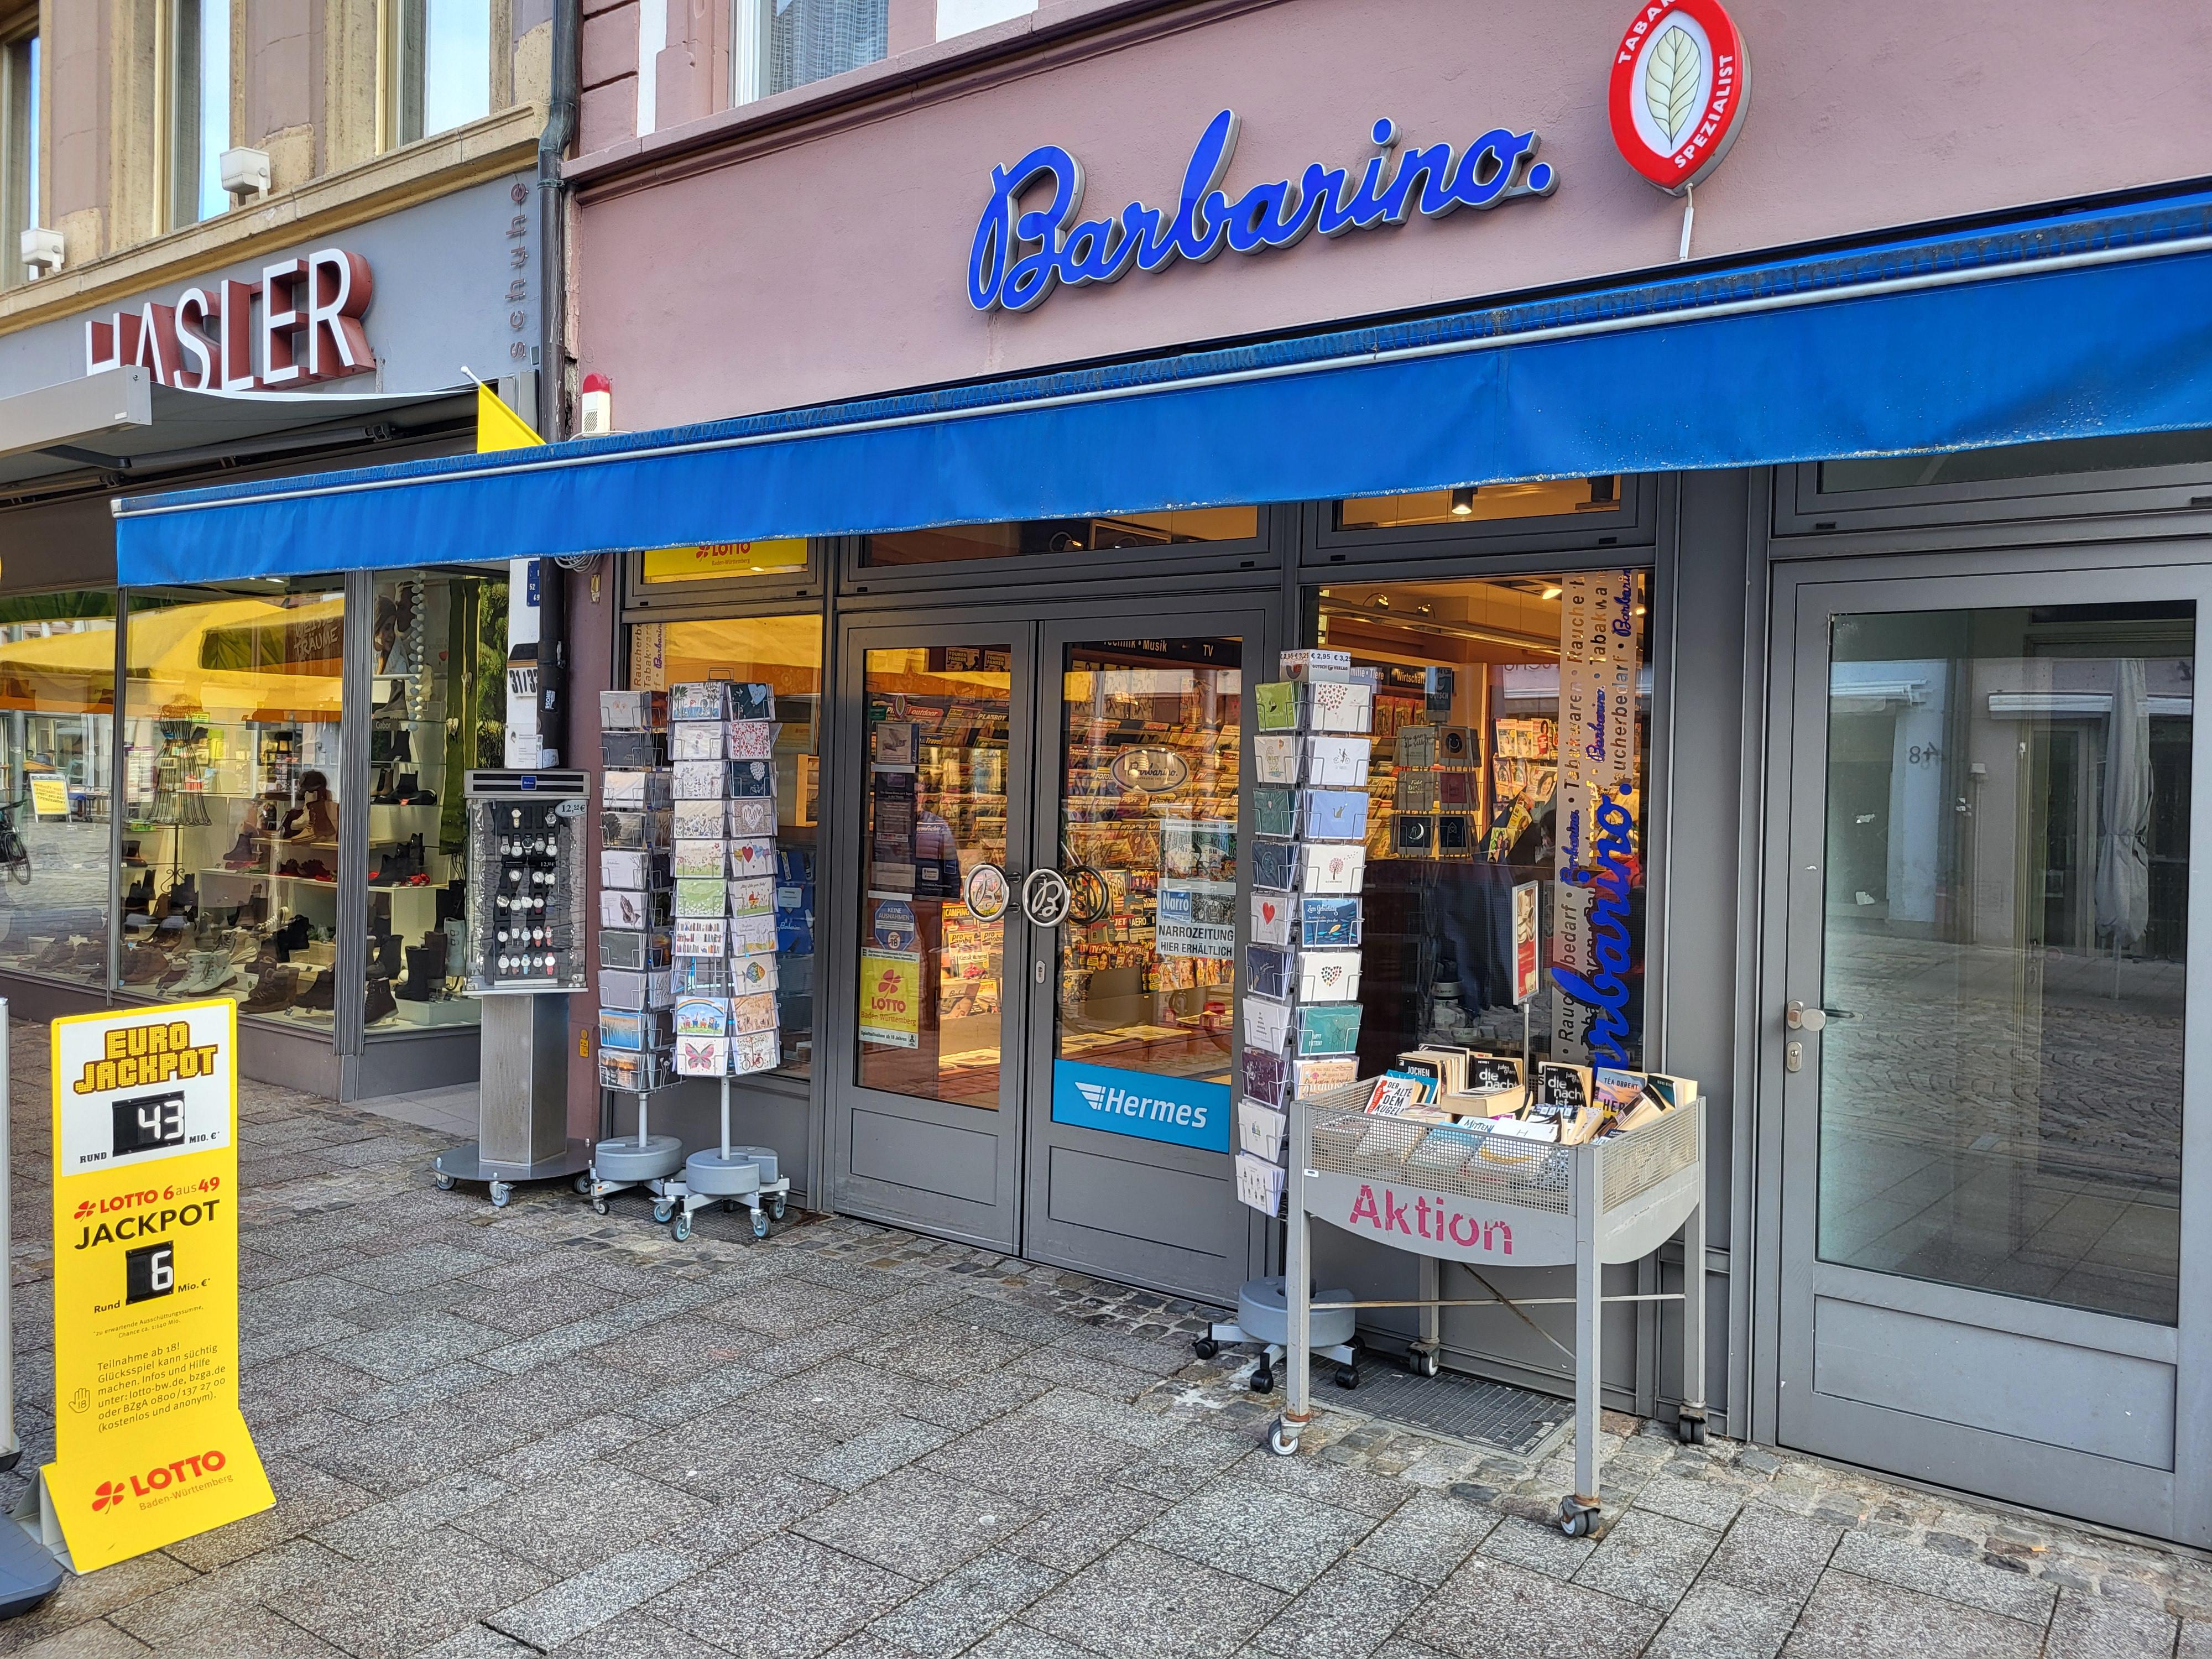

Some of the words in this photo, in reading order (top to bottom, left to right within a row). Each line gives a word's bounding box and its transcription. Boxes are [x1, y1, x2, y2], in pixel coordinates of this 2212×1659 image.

[1674, 55, 1733, 168] SPEZIALIST
[504, 182, 529, 358] schuhe
[86, 248, 365, 394] HASLER
[712, 542, 750, 557] LOTTO
[712, 558, 750, 566] Baden-Württemberg
[294, 626, 338, 657] TRÄUME
[1104, 640, 1135, 649] echnik
[1142, 639, 1167, 653] Musik
[1203, 644, 1214, 657] TV
[1370, 669, 1385, 681] Tiere
[1396, 670, 1425, 685] Wirtschaft
[911, 707, 938, 717] outdoor
[375, 721, 391, 729] Gabor
[1163, 891, 1189, 911] Narro
[945, 909, 970, 917] CAMPING
[1131, 917, 1147, 927] AERO
[1159, 925, 1234, 942] NARROZEITUNG
[1161, 942, 1179, 952] HIER
[1181, 942, 1232, 957] ERHÄLTLICH
[871, 996, 906, 1013] LOTTO
[105, 1021, 190, 1060] EURO
[73, 1044, 218, 1095] JACKPOT
[1407, 1066, 1430, 1077] JOCHEN
[1479, 1067, 1499, 1081] die
[1387, 1081, 1400, 1089] DER
[1394, 1086, 1412, 1097] ALTE
[1547, 1077, 1567, 1089] die
[1604, 1077, 1615, 1085] TÉA
[1616, 1080, 1639, 1091] OBREHT
[1382, 1094, 1404, 1107] DEM
[1553, 1087, 1584, 1100] nacht
[1555, 1096, 1569, 1106] ist
[1104, 1087, 1208, 1129] Hermes
[138, 1099, 185, 1140] 43
[80, 1151, 107, 1164] RUND
[189, 1134, 209, 1145] MIO.
[100, 1188, 158, 1214] LOTTO
[74, 1199, 220, 1250] JACKPOT
[1349, 1184, 1513, 1255] Aktion
[151, 1251, 174, 1292] 6
[94, 1300, 121, 1314] Rund
[178, 1281, 200, 1293] Mio.
[105, 1321, 138, 1334] erwartende
[118, 1328, 140, 1338] Chance
[97, 1351, 149, 1371] Teilnahme
[151, 1347, 163, 1357] ab
[166, 1342, 180, 1353] 18!
[98, 1360, 155, 1384] Glücksspiel
[158, 1355, 181, 1367] kann
[184, 1345, 218, 1360] süchtig
[98, 1379, 140, 1396] machen.
[142, 1371, 166, 1384] Infos
[169, 1364, 186, 1376] und
[189, 1358, 210, 1371] Hilfe
[98, 1394, 128, 1408] unter:
[129, 1377, 186, 1400] lotto-bw.de,
[190, 1365, 226, 1383] bzga.de
[78, 1400, 87, 1409] 18
[98, 1407, 121, 1420] oder
[123, 1399, 149, 1413] BZgA
[150, 1386, 197, 1406] 0800/137
[200, 1382, 211, 1392] 27
[213, 1378, 226, 1387] 00
[98, 1411, 150, 1433] (kostenlos
[153, 1404, 171, 1416] und
[173, 1391, 216, 1411] anonym).
[130, 1451, 226, 1497] LOTTO
[139, 1475, 234, 1511] Baden-Württemberg
